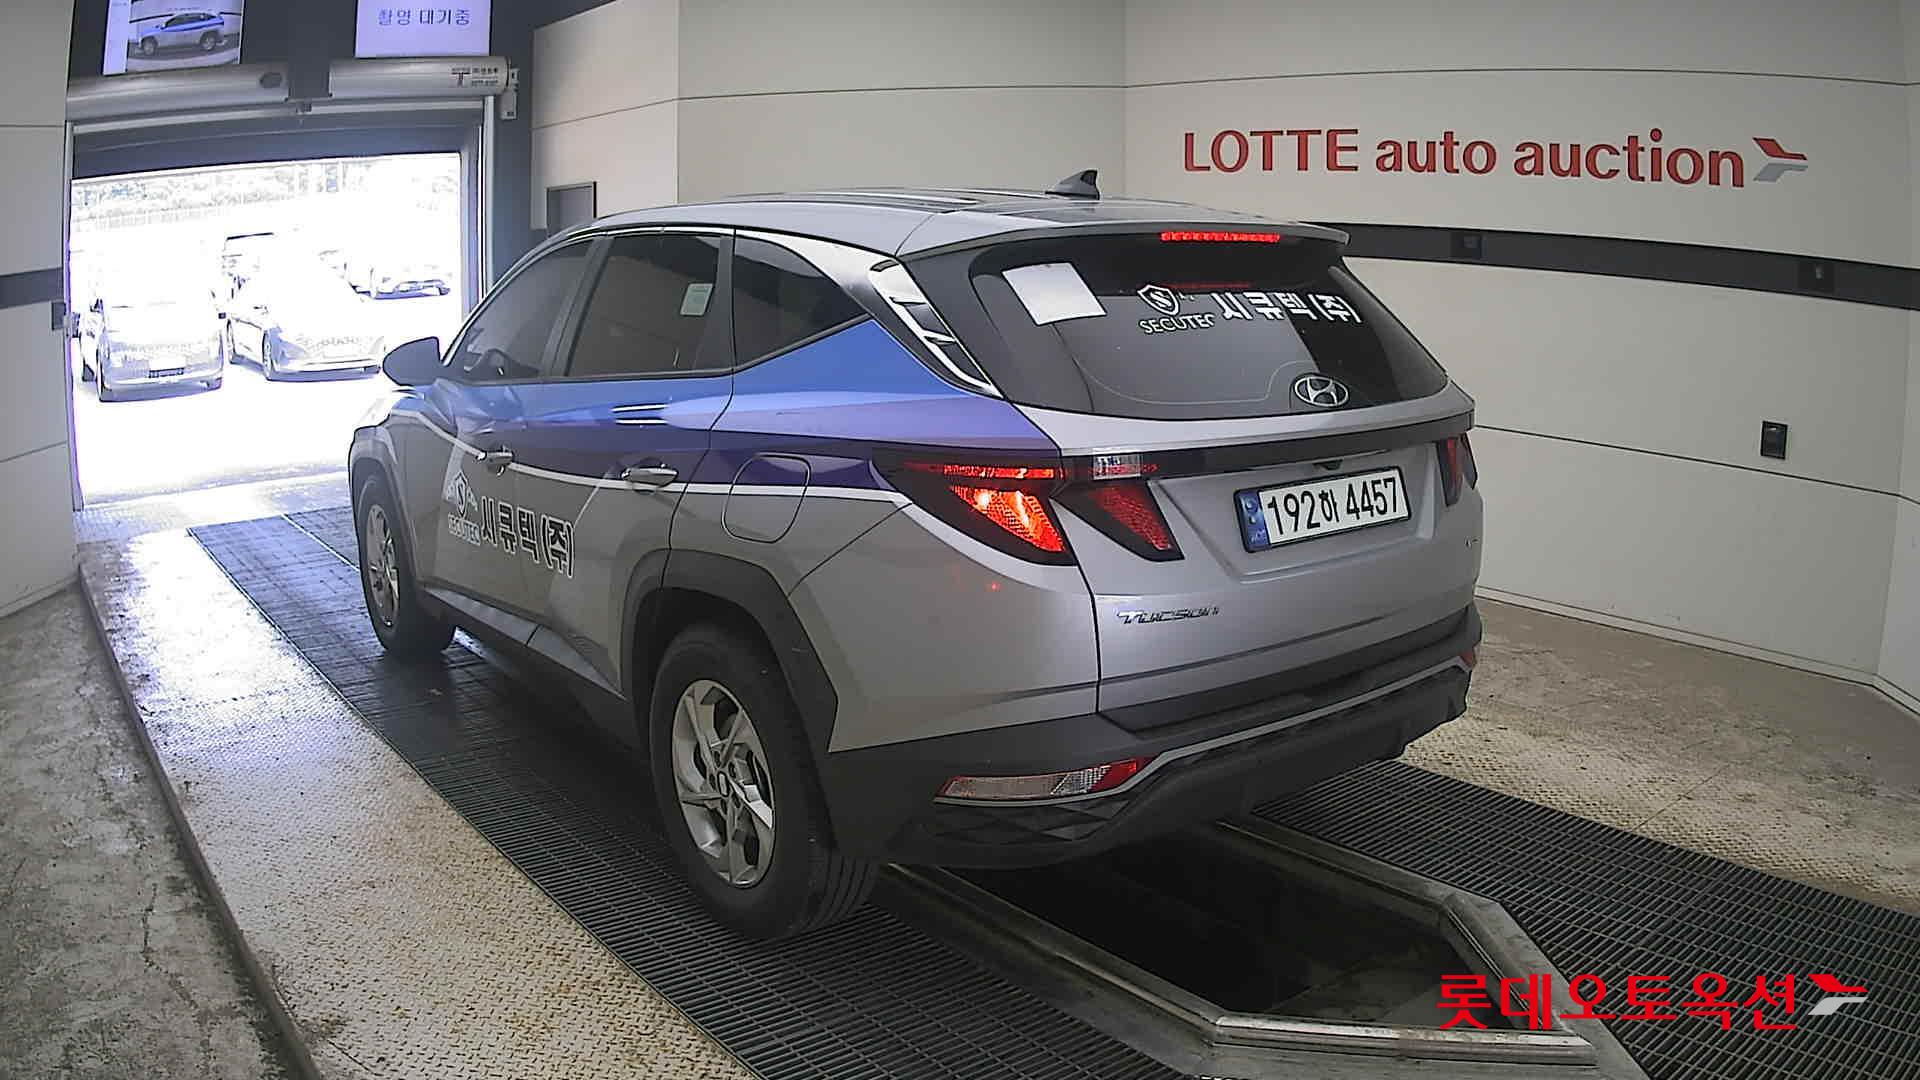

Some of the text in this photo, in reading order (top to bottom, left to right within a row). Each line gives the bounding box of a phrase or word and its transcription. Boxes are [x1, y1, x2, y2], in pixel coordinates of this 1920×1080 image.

[419, 8, 471, 26] 대기중
[1184, 128, 1745, 188] LOTTE auto auction
[1267, 476, 1398, 536] 192하 4457
[481, 495, 574, 579] 시큐텍(주)
